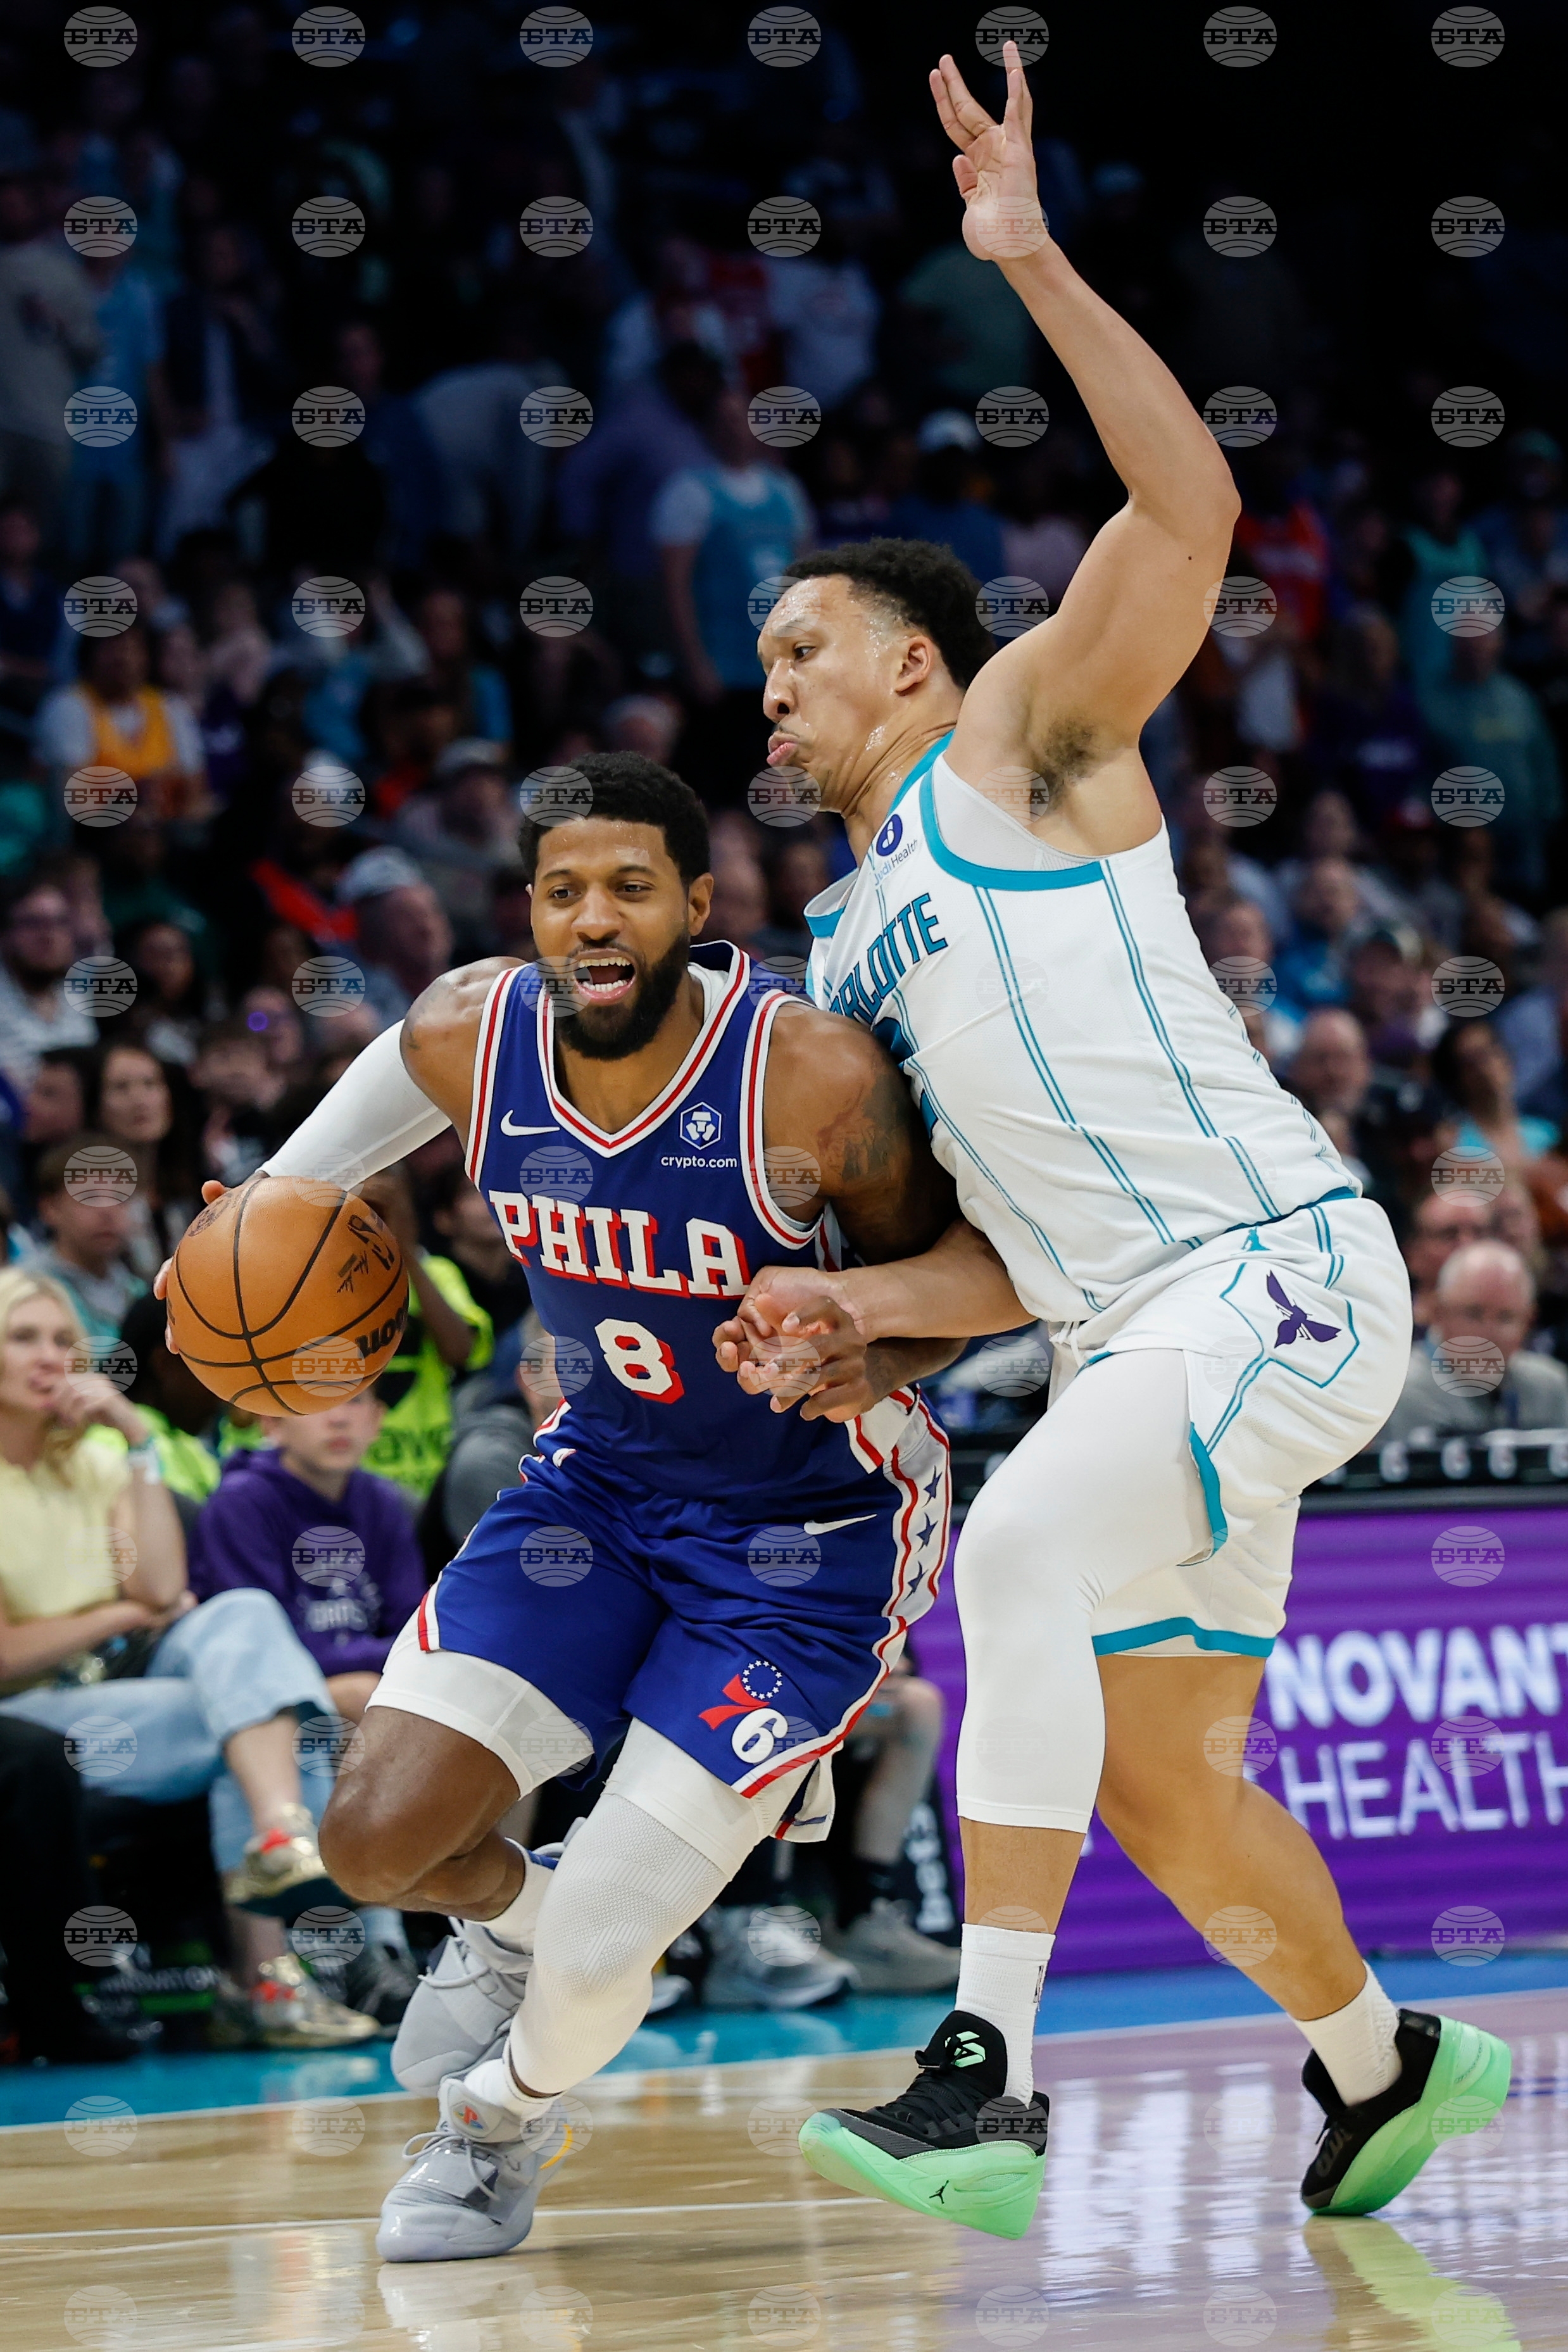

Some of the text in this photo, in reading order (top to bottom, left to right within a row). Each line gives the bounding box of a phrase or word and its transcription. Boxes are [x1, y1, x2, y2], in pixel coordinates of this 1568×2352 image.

[875, 839, 917, 886] Judi Health
[661, 1155, 737, 1169] crypto.com
[488, 1190, 751, 1300] PHILA
[594, 1318, 685, 1404] 8
